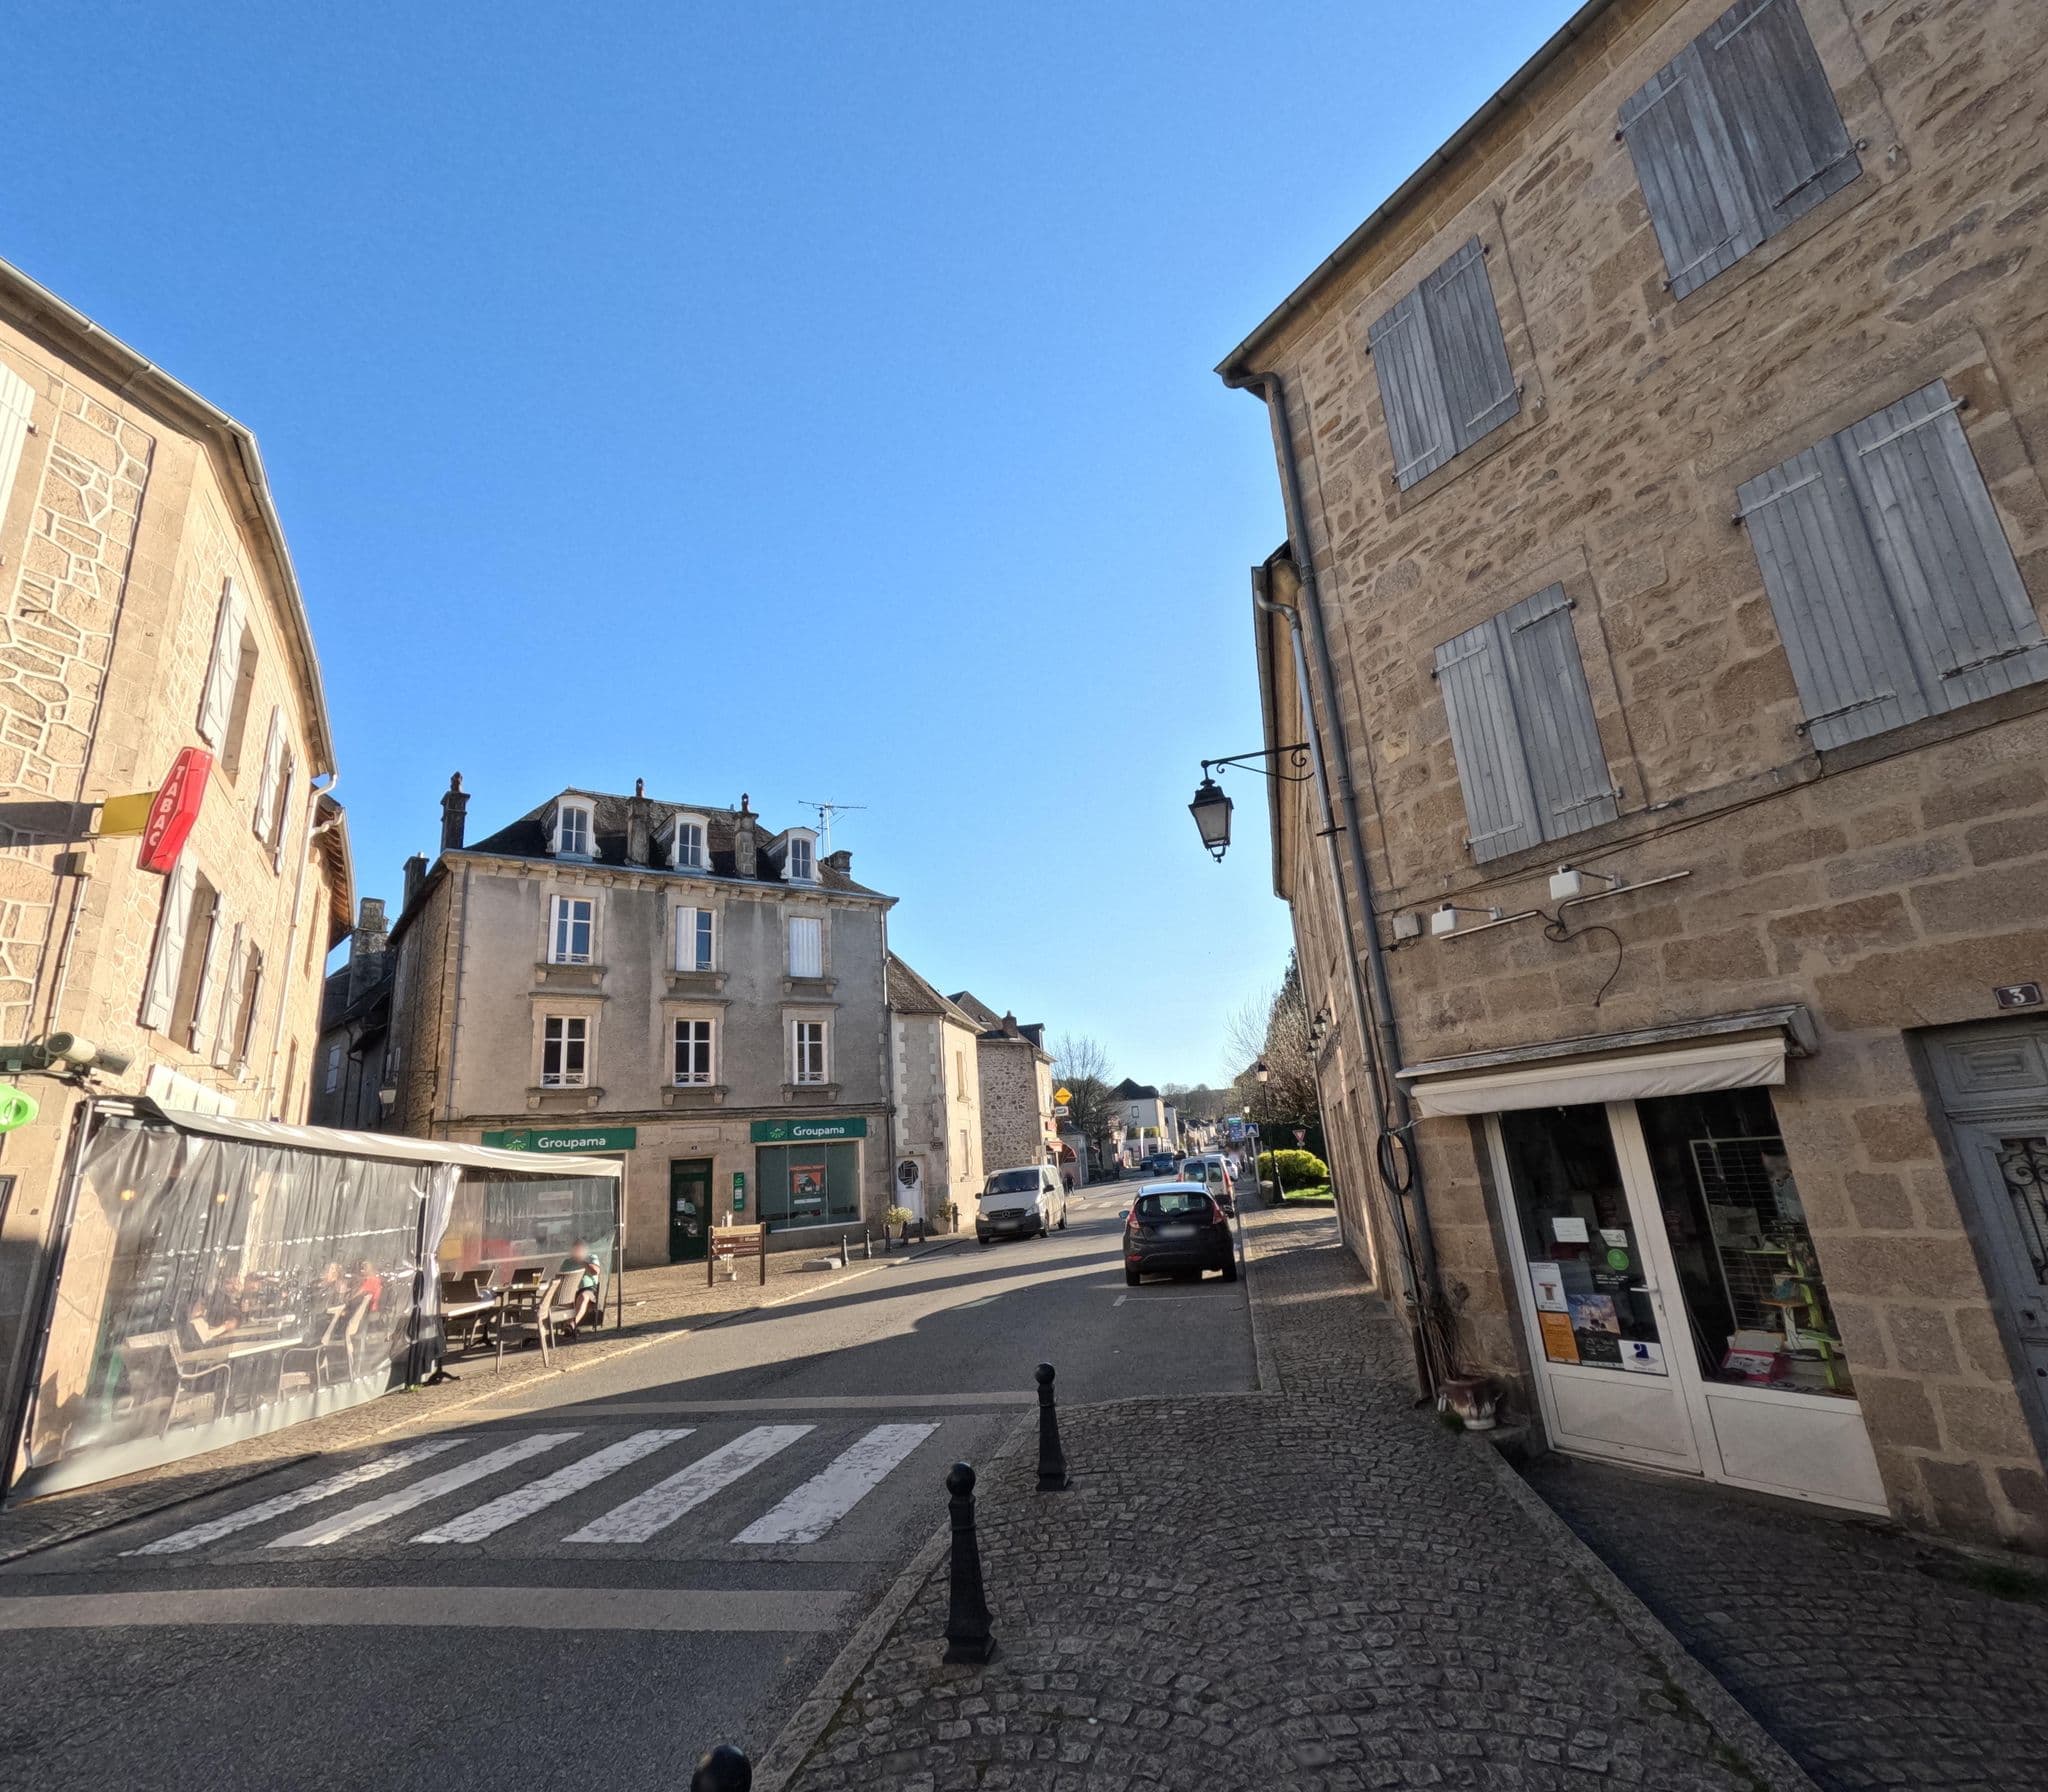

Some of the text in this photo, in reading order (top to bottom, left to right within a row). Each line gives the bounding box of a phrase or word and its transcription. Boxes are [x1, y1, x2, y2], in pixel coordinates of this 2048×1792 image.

[149, 765, 185, 847] TABAC
[2008, 988, 2026, 1003] 3
[793, 1126, 845, 1137] Groupama
[537, 1137, 607, 1149] Groupama
